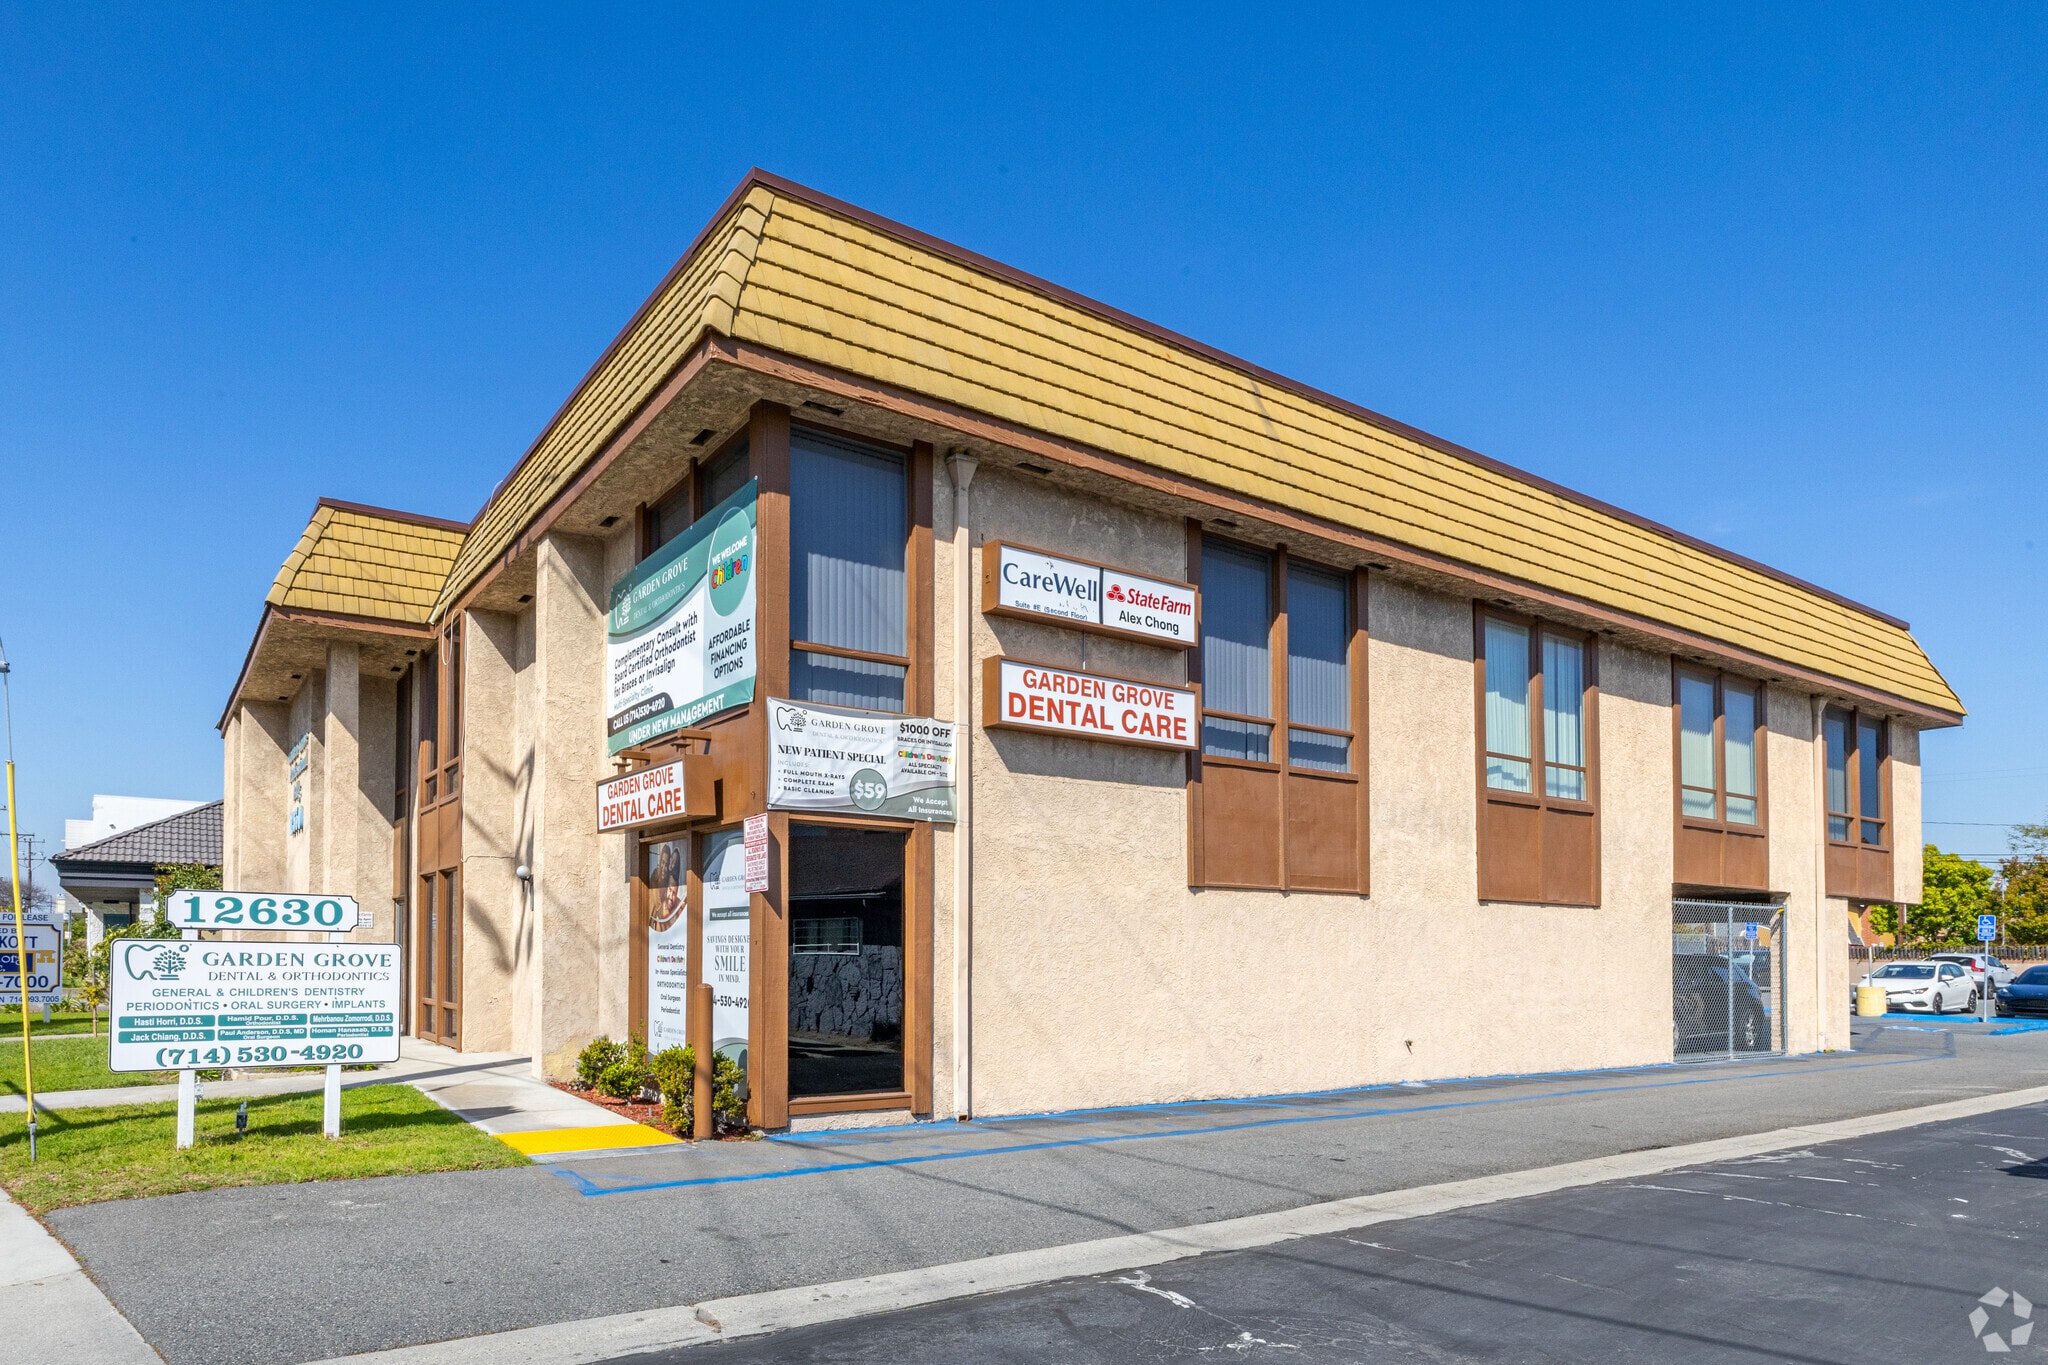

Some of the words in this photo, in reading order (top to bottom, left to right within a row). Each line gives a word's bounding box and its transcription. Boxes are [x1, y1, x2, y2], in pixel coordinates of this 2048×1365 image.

[712, 556, 721, 566] WE
[721, 535, 748, 563] WELCOME
[632, 576, 660, 603] GARDEN
[661, 557, 688, 584] GROVE
[711, 554, 749, 589] Children
[1003, 562, 1097, 601] CareWell
[1015, 600, 1030, 609] Suite
[1044, 606, 1068, 617] (Second
[1119, 611, 1142, 626] Alex
[1145, 616, 1179, 635] Chong
[614, 638, 655, 669] Complementary
[657, 621, 681, 645] Consult
[682, 611, 698, 630] with
[708, 619, 751, 650] AFFORDABLE
[614, 665, 628, 684] Board
[628, 649, 653, 675] Certified
[654, 630, 696, 661] Orthodontist
[710, 637, 747, 665] FINANCING
[621, 677, 638, 694] Braces
[638, 673, 646, 684] or
[646, 658, 676, 681] Invisalign
[713, 656, 744, 679] OPTIONS
[1023, 669, 1106, 700] GARDEN
[1112, 684, 1174, 710] GROVE
[612, 716, 624, 730] CALL
[628, 725, 651, 743] UNDER
[652, 717, 669, 735] NEW
[669, 693, 725, 728] MANAGEMENT
[1008, 692, 1114, 731] DENTAL
[1121, 709, 1187, 741] CARE
[811, 718, 851, 730] GARDEN
[854, 723, 887, 735] GROVE
[899, 721, 930, 735] $1000
[932, 727, 951, 738] OFF
[897, 736, 918, 744] BRACES
[926, 739, 952, 748] INVISALIGN
[778, 744, 802, 755] NEW
[804, 747, 845, 760] PATIENT
[847, 752, 886, 764] SPECIAL
[901, 767, 927, 775] AVAILABLE
[607, 776, 640, 799] GARDEN
[642, 766, 674, 791] GROVE
[783, 777, 816, 786] COMPLETE
[853, 780, 885, 800] $59
[804, 787, 834, 795] CLEANING
[603, 798, 645, 826] DENTAL
[647, 787, 681, 817] CARE
[925, 797, 948, 806] Accept
[918, 807, 952, 816] Insurances
[2, 913, 20, 921] FO
[183, 896, 344, 926] 12630
[706, 935, 727, 943] SAVINGS
[715, 945, 729, 953] WITH
[730, 945, 744, 953] YOUR
[202, 952, 304, 966] GARDEN
[313, 953, 392, 967] GROVE
[714, 955, 746, 972] SMILE
[208, 971, 262, 980] DENTAL
[268, 972, 277, 980] &
[282, 971, 389, 981] ORTHODONTICS
[719, 974, 724, 982] IN
[725, 974, 740, 983] MIND.
[152, 988, 211, 997] GENERAL
[216, 988, 224, 997] &
[229, 987, 298, 996] CHILDREN'S
[305, 987, 365, 996] DENTISTRY
[657, 981, 685, 989] ORTHODONTICS
[127, 1001, 219, 1011] PERIODONTICS
[231, 1001, 263, 1010] ORAL
[267, 1000, 321, 1009] SURGERY
[332, 1000, 386, 1009] IMPLANTS
[134, 1018, 154, 1026] Hasti
[156, 1017, 178, 1026] Horri,
[180, 1017, 203, 1025] D.D.S.
[130, 1033, 151, 1041] Jack
[151, 1032, 181, 1042] Chiang,
[182, 1031, 206, 1040] D.D.S.
[156, 1046, 231, 1067] (714)
